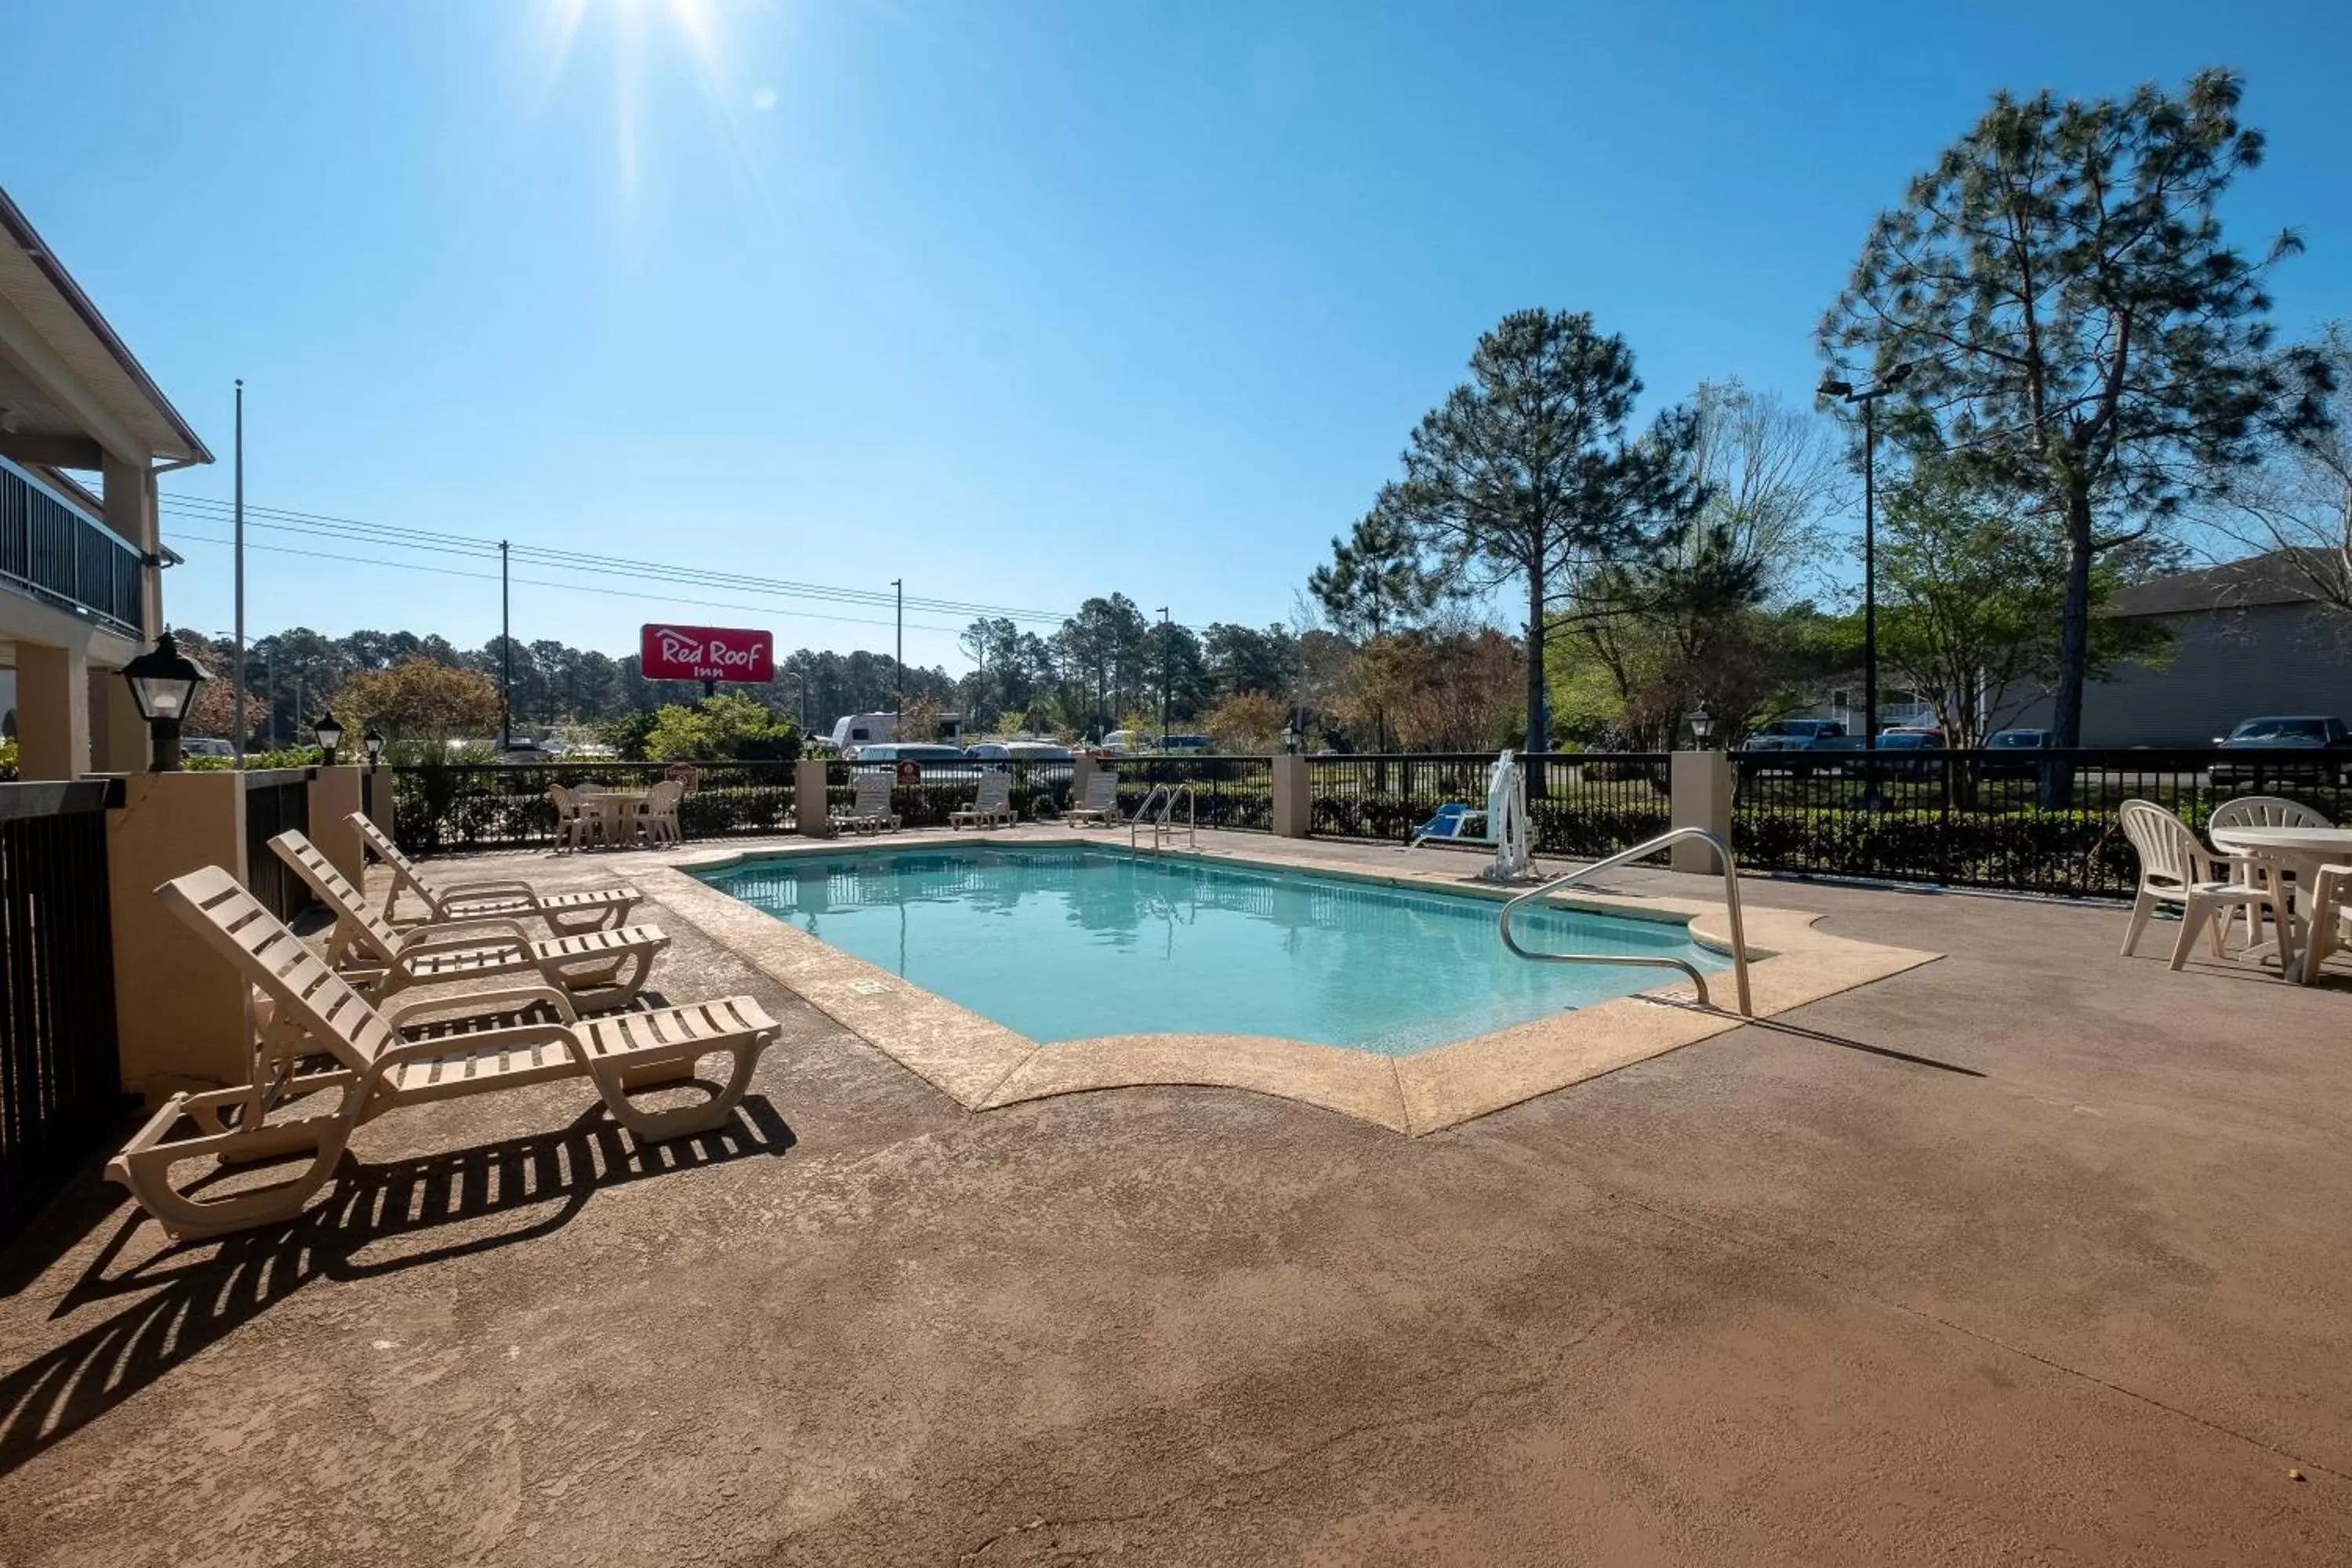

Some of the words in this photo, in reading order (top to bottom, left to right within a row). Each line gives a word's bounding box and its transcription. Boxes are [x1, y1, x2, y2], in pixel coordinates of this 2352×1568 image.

[662, 637, 703, 664] Red
[710, 641, 764, 671] Roof
[694, 666, 724, 677] Inn
